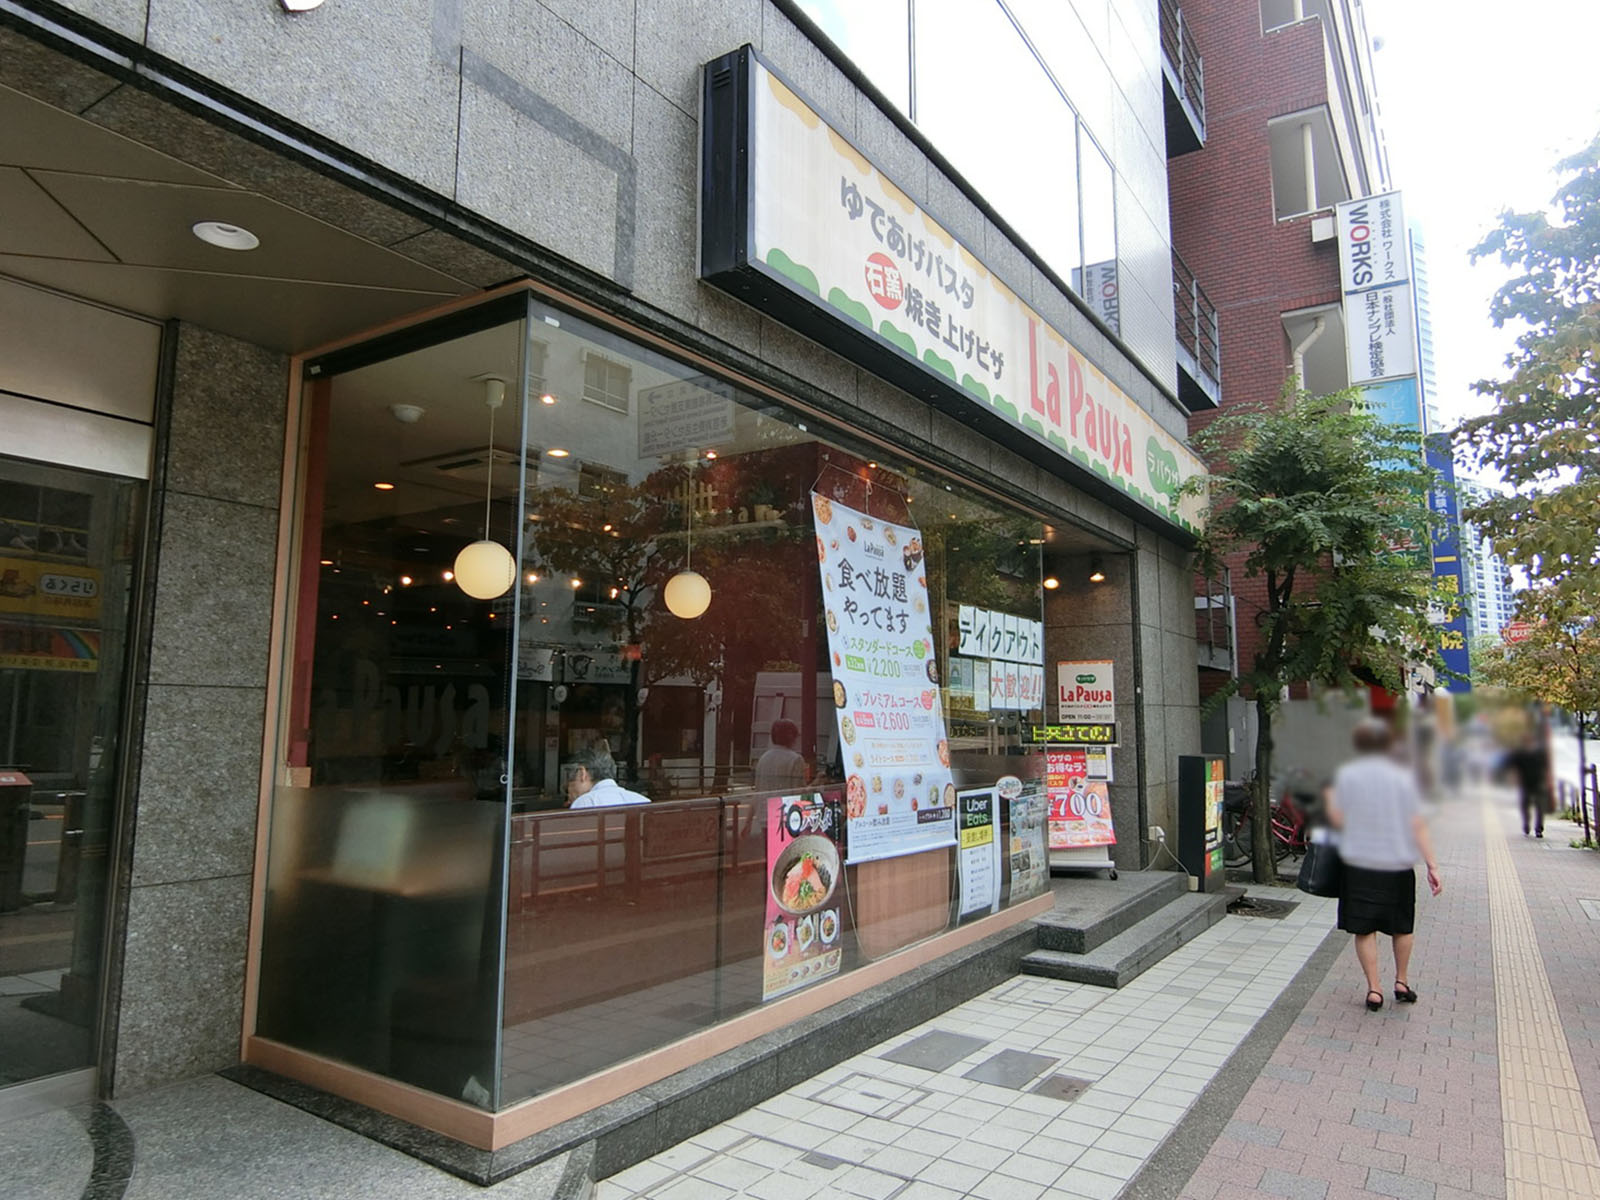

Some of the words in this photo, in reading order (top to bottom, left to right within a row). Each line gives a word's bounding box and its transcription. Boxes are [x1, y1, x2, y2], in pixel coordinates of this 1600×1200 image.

[841, 176, 975, 310] ゆであげパスタ
[1349, 203, 1373, 286] WORKS
[1029, 317, 1062, 428] La
[1068, 350, 1133, 477] Pausa
[837, 558, 909, 604] 食べ放題
[844, 596, 909, 634] やってます
[851, 637, 914, 657] スタンダードコース
[960, 620, 1040, 659] テイクアウト
[862, 690, 921, 709] プレミアムコース
[1061, 685, 1074, 702] La
[1076, 685, 1112, 703] Pausa
[966, 799, 988, 812] Uber
[967, 813, 988, 826] Eats
